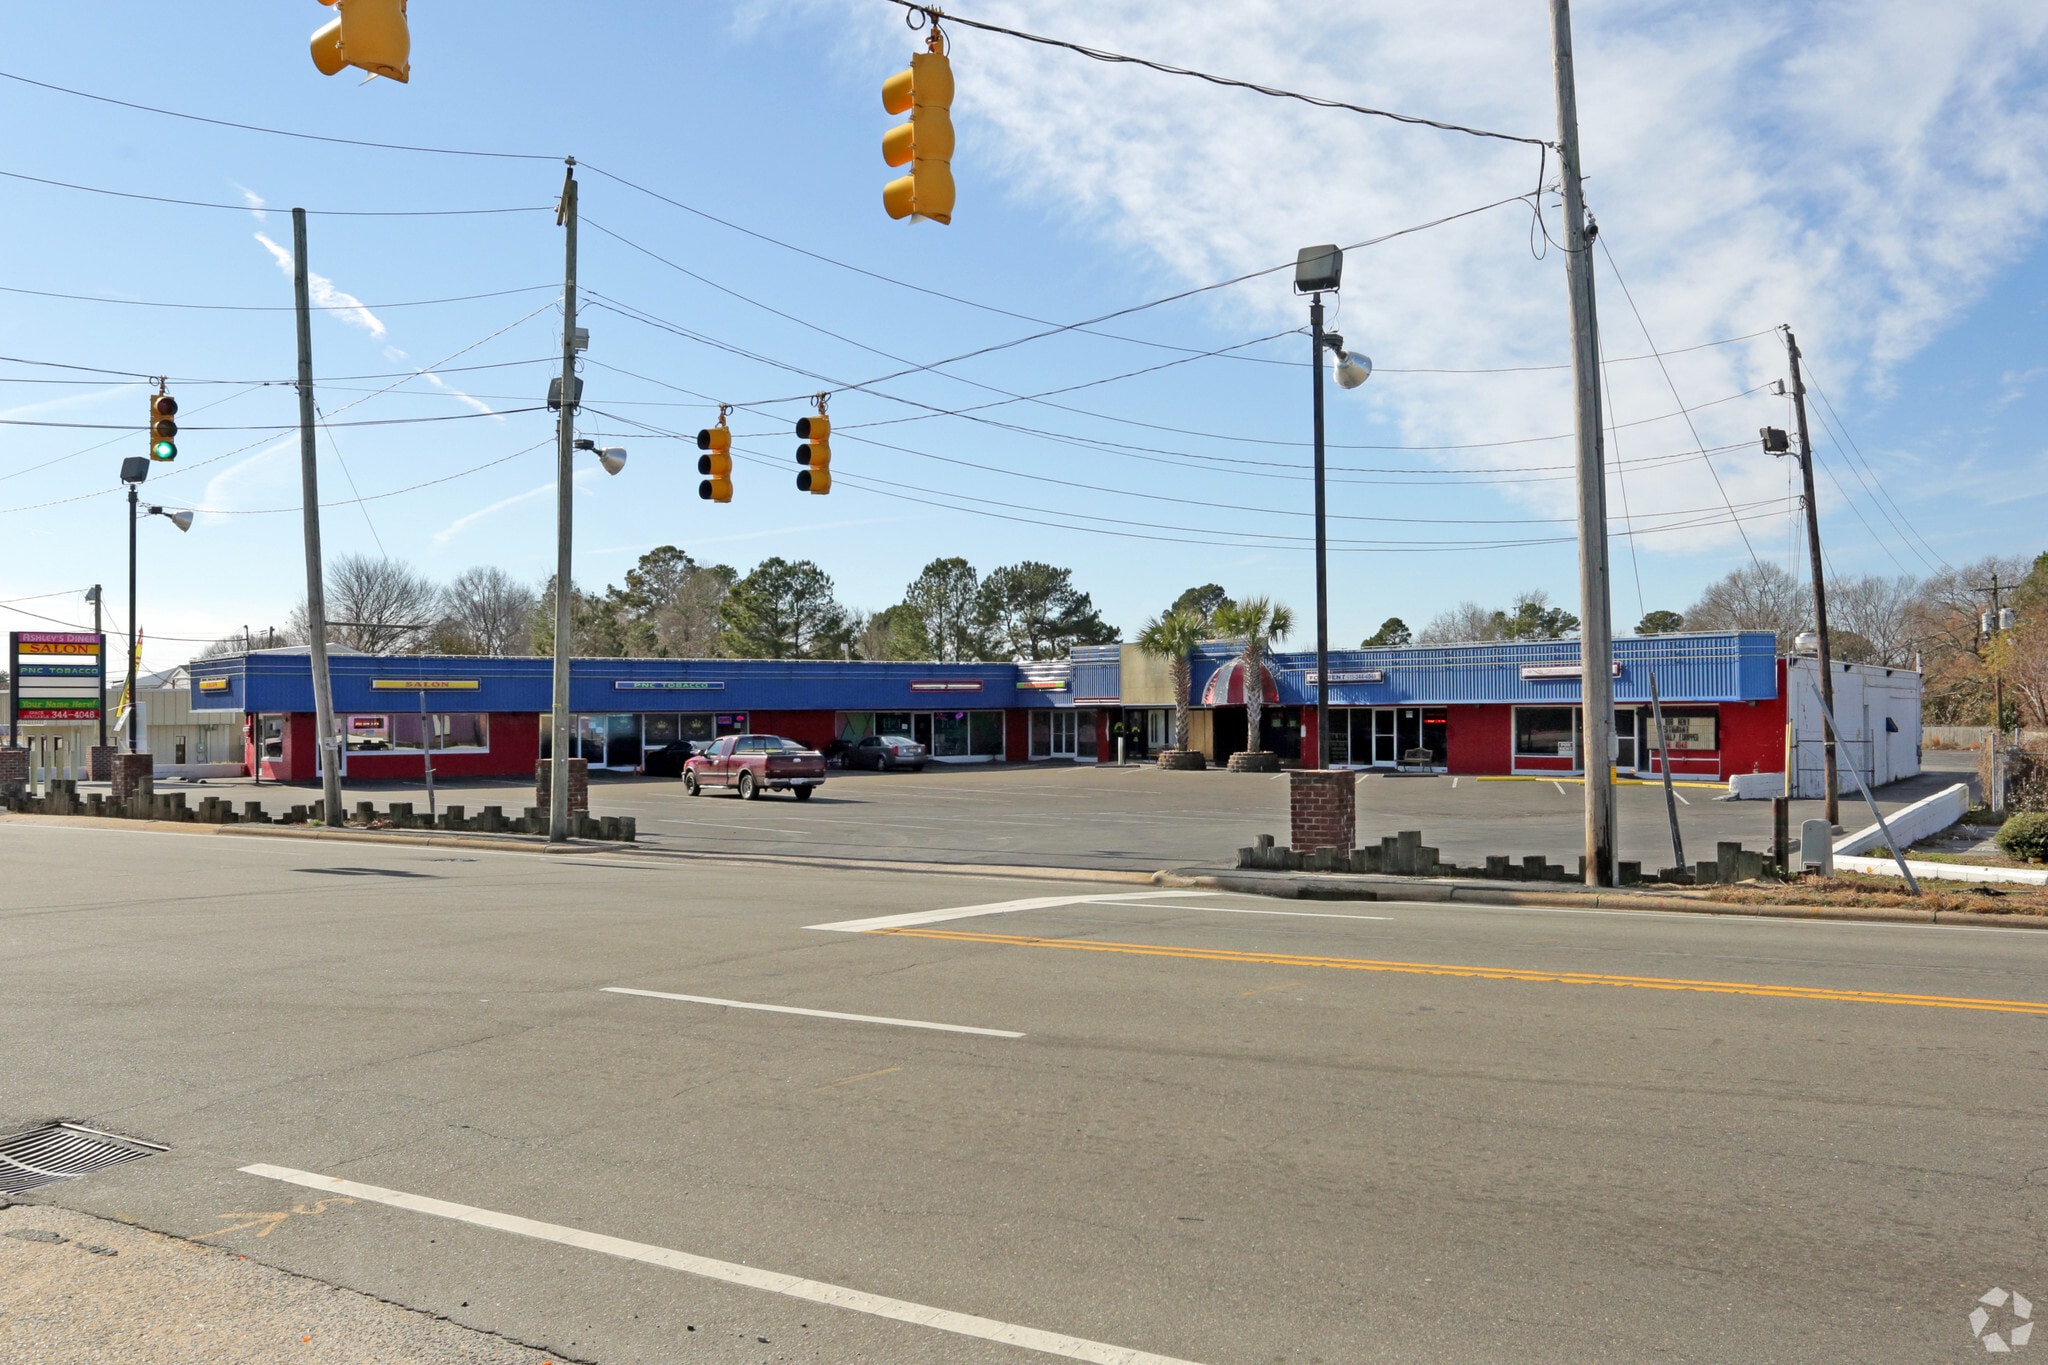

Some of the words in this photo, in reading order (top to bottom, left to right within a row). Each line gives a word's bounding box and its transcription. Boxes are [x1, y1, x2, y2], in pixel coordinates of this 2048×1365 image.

[67, 634, 96, 643] DINER
[30, 644, 88, 653] SALON
[51, 711, 95, 719] 344-4048
